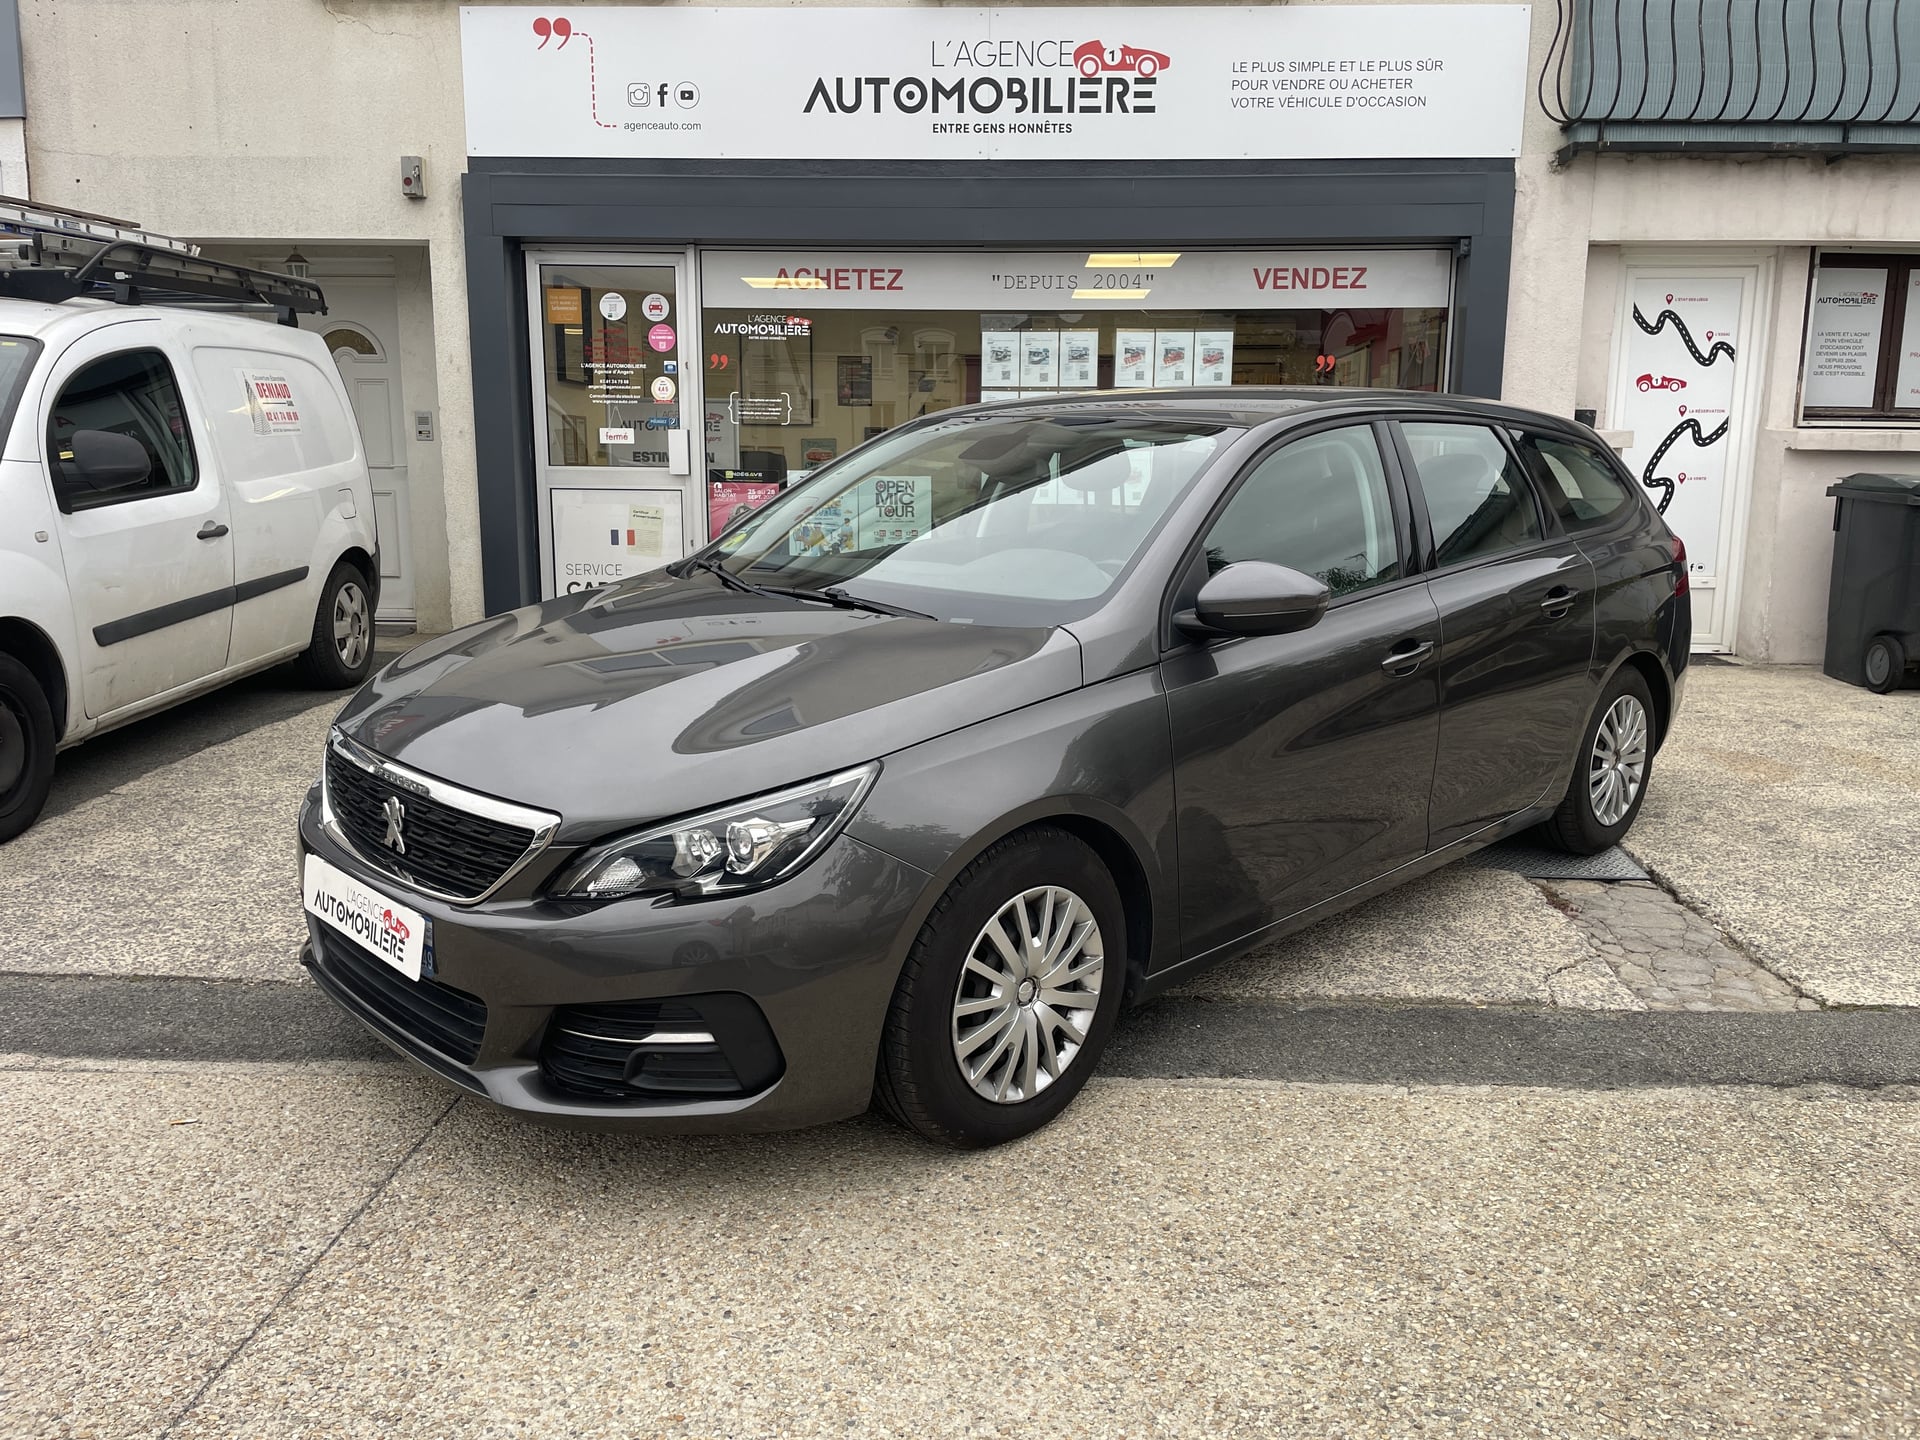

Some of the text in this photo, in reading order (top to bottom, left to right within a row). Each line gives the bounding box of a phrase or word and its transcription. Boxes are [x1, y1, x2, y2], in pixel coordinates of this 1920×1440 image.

[931, 40, 1074, 67] L'AGENCE
[1232, 57, 1444, 73] LE PLUS SIMPLE ET LE PLUS SÛR
[1231, 78, 1413, 91] POUR VENDRE OU ACHETER
[1230, 94, 1427, 109] VOTRE VÉHICULE D'OCCASION
[623, 121, 702, 132] agenceauto.com
[932, 120, 1073, 134] ENTRE GENS HONNÊTES
[772, 267, 904, 291] ACHETEZ
[991, 273, 1154, 290] "DEPUIS 2004"
[1252, 267, 1368, 290] VENDEZ
[255, 382, 292, 399] DENIAUD
[605, 431, 629, 441] fermé
[875, 480, 915, 493] OPEN
[875, 492, 915, 505] MIC
[875, 505, 915, 518] TOUR
[565, 563, 623, 576] SERVICE
[345, 886, 385, 924] L'AGENCE
